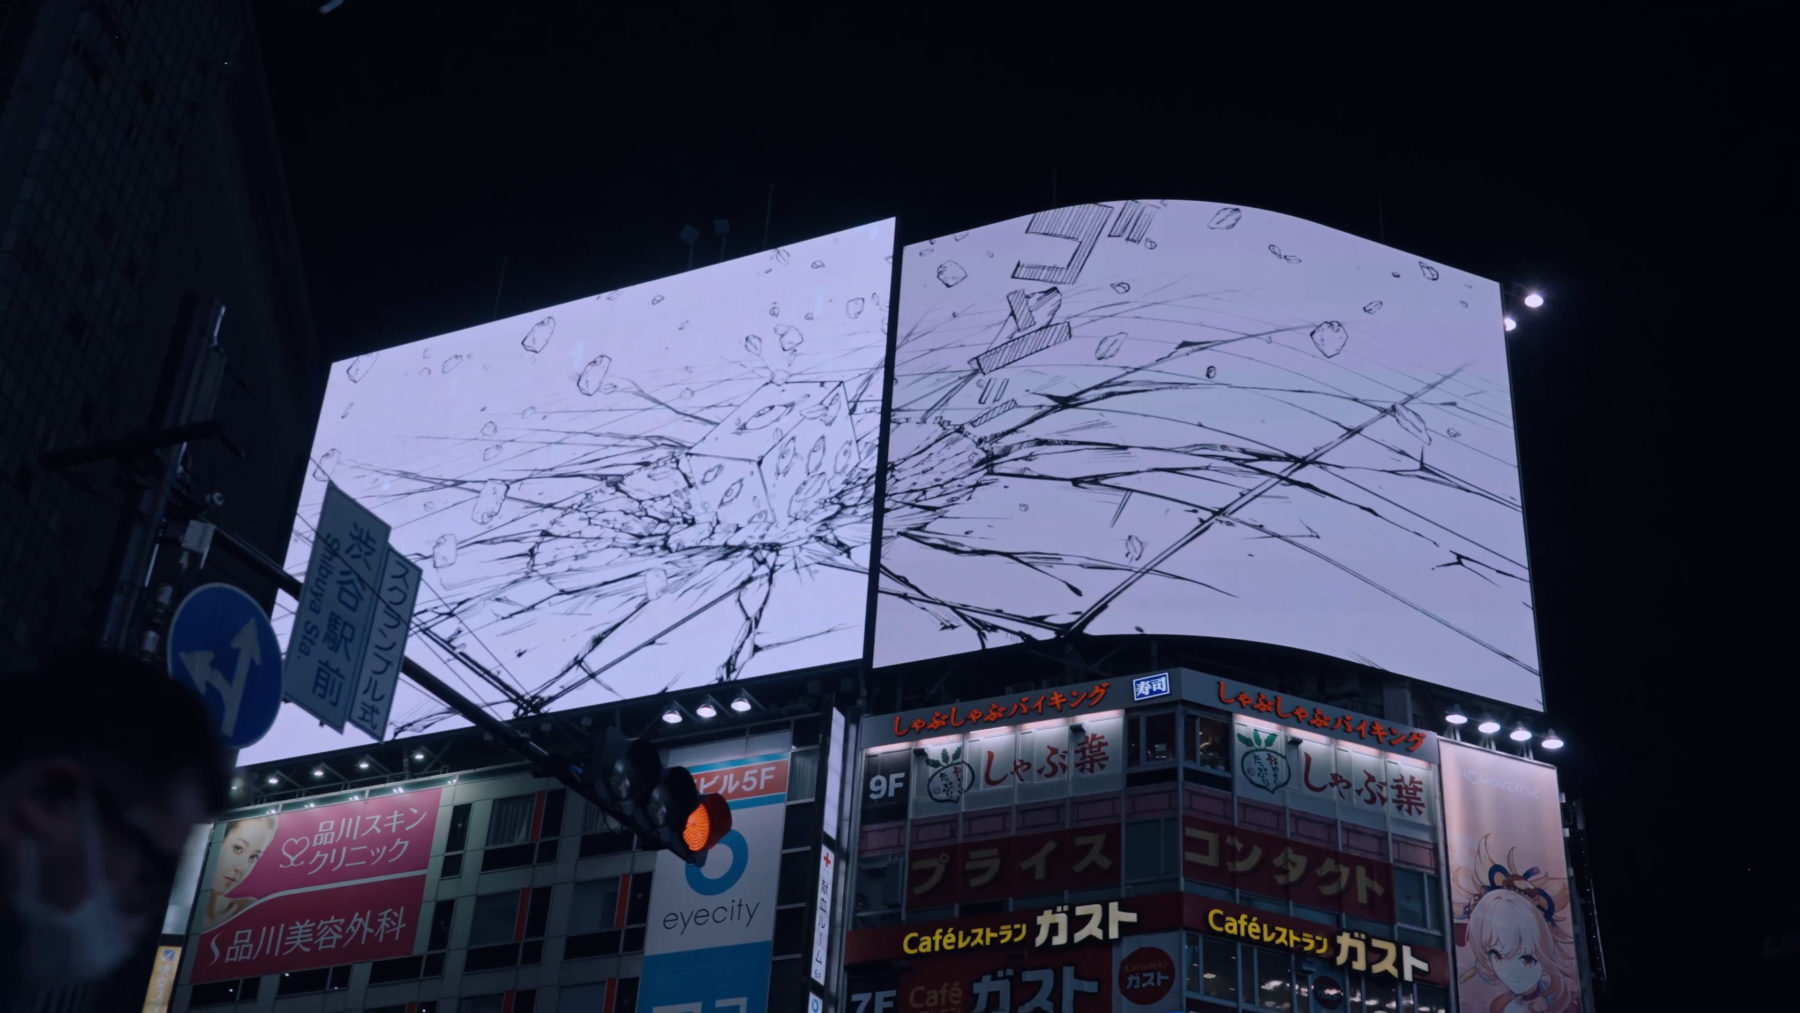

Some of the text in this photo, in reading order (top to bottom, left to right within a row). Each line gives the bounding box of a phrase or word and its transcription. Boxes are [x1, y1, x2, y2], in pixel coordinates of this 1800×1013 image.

[308, 533, 342, 614] Shibuya
[311, 521, 376, 707] 渋谷駅前
[357, 560, 410, 730] スクランブル式
[893, 682, 1111, 737] しゃぶしゃぶバイキング
[1135, 676, 1168, 697] 寿司
[1217, 680, 1427, 752] しゃぶしゃぶバイキング
[694, 766, 777, 795] ビル5F
[984, 732, 1110, 786] しゃぶ葉
[1303, 751, 1427, 817] しゃぶ葉
[868, 772, 906, 800] 9F
[312, 807, 428, 847] 品川スキン
[308, 838, 410, 876] クリニック
[911, 832, 1114, 896] プライス
[1184, 826, 1385, 904] コンタクト
[225, 906, 407, 964] 品川美容外科
[663, 898, 761, 936] eyecity
[1035, 901, 1138, 948] ガスト
[1126, 971, 1170, 991] ガスト
[1335, 931, 1430, 983] ガスト
[909, 981, 964, 1009] Café
[971, 965, 1099, 1013] ガスト
